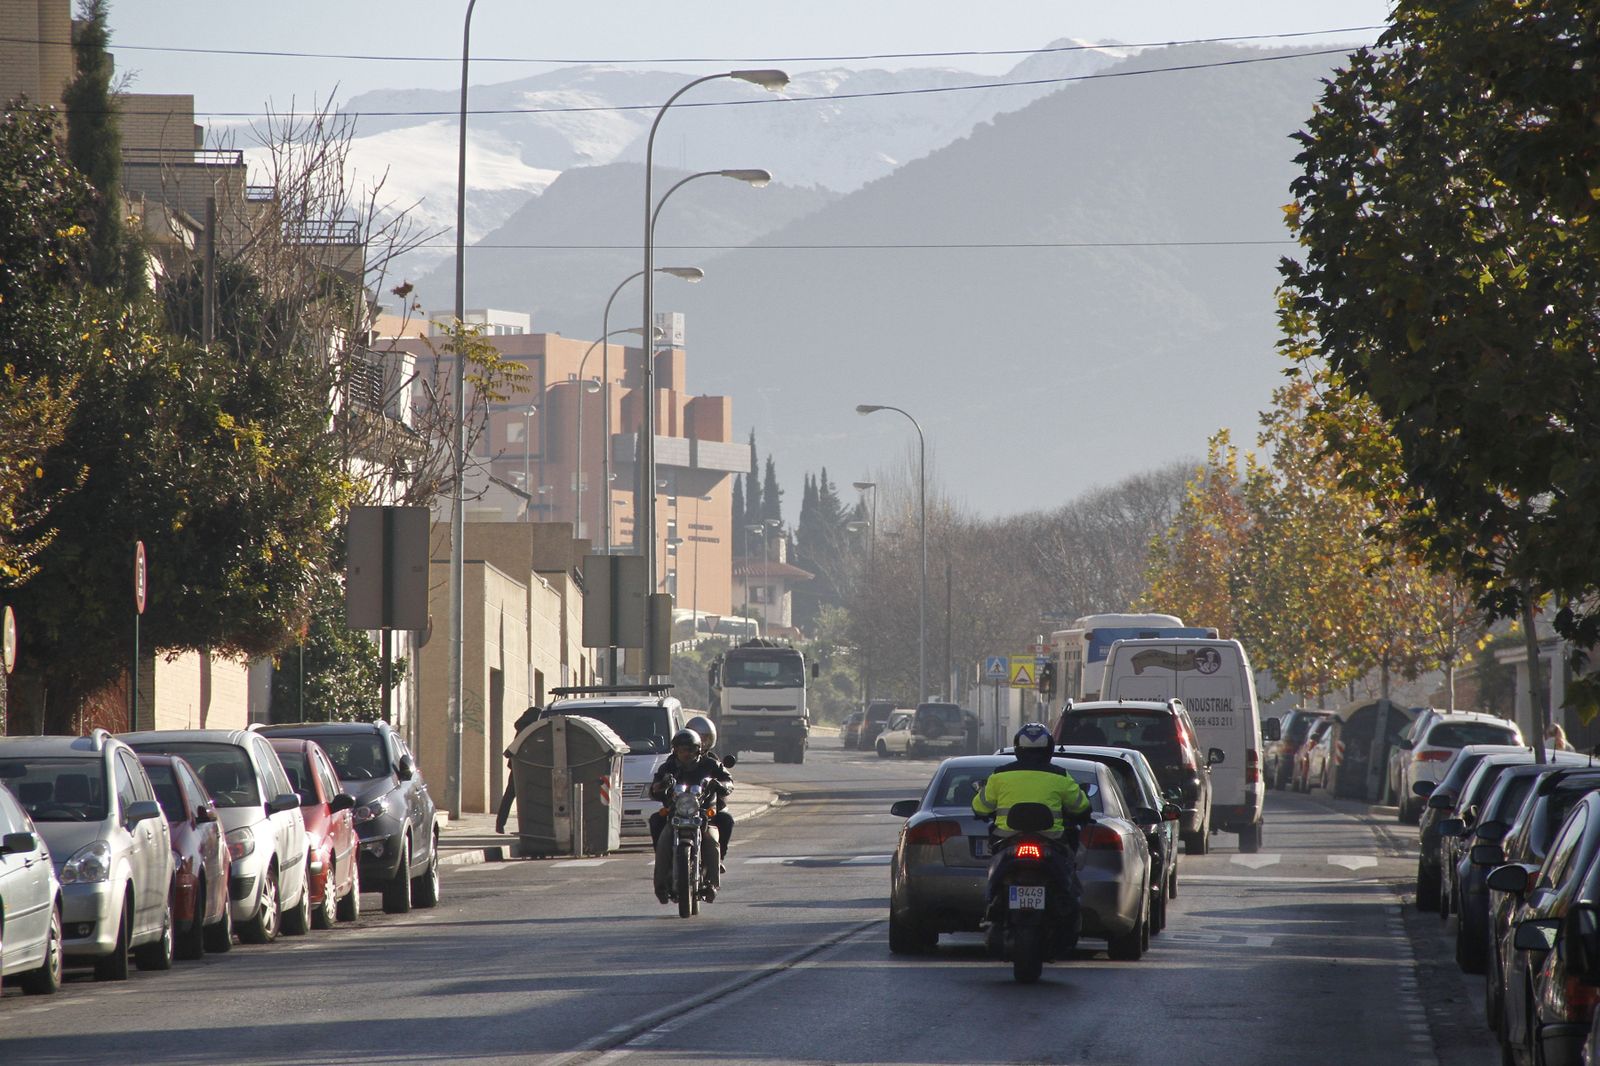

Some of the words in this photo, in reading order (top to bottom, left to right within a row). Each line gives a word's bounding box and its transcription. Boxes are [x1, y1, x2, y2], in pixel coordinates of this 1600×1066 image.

[1186, 697, 1234, 712] INDUSTRIAL
[1207, 716, 1219, 726] 433
[1221, 716, 1233, 726] 211
[1018, 888, 1043, 897] 9449
[1020, 898, 1042, 908] HRP
